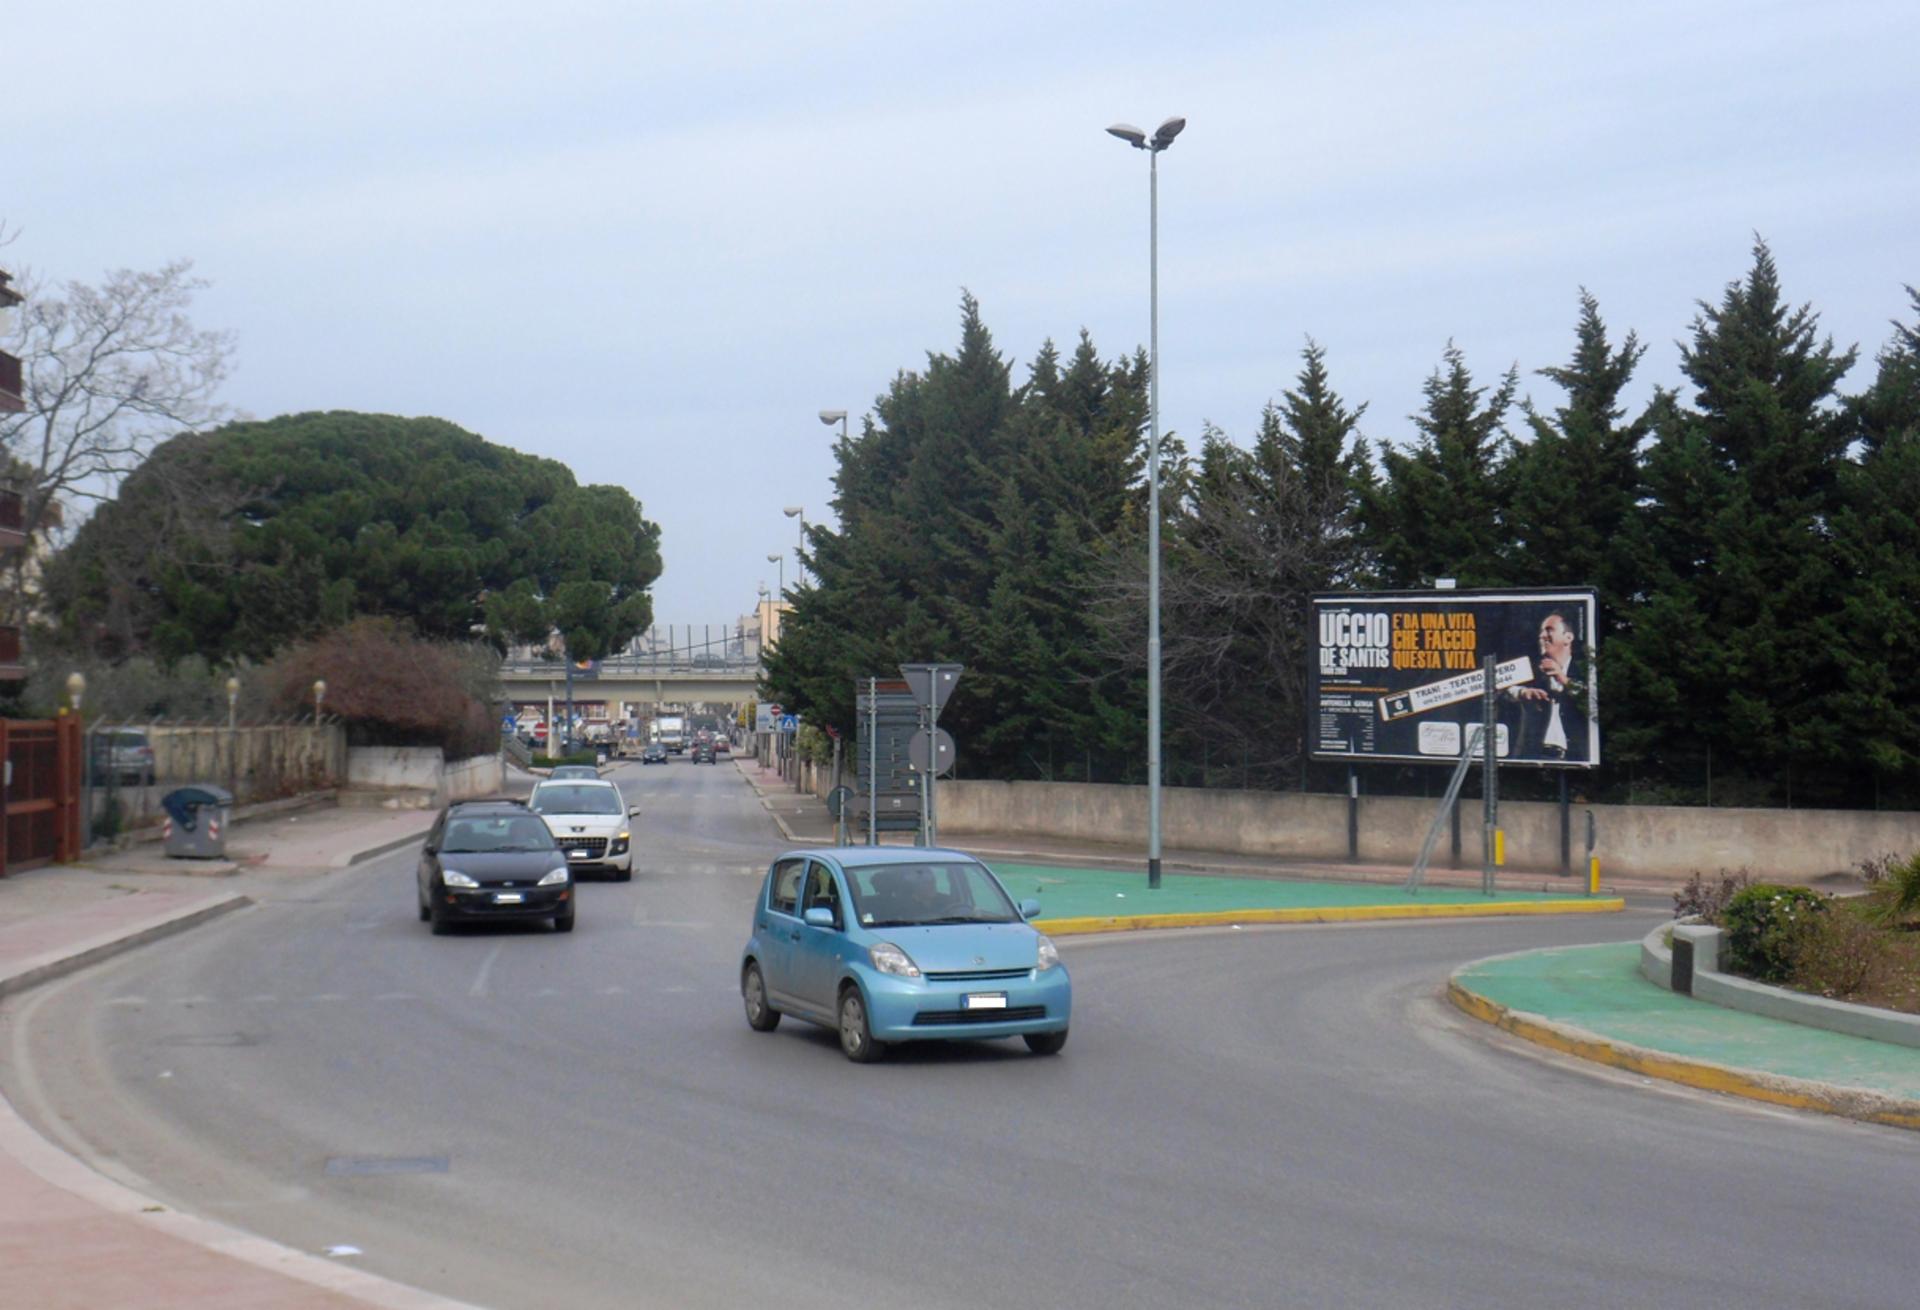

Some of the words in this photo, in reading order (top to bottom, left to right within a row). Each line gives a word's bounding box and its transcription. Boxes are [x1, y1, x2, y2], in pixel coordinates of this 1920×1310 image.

[1319, 613, 1390, 648] UCCIO
[1404, 613, 1420, 630] DA
[1421, 613, 1447, 630] UNA
[1448, 613, 1476, 630] VITA
[1392, 630, 1420, 650] CHE
[1424, 630, 1476, 650] FACCIO
[1319, 648, 1337, 667] DE
[1339, 648, 1390, 668] SANTIS
[1392, 650, 1443, 671] QUESTA
[1444, 650, 1476, 669] VITA
[1415, 683, 1440, 698] TRANI
[1449, 673, 1484, 689] TEATRO
[1394, 700, 1404, 710] 6
